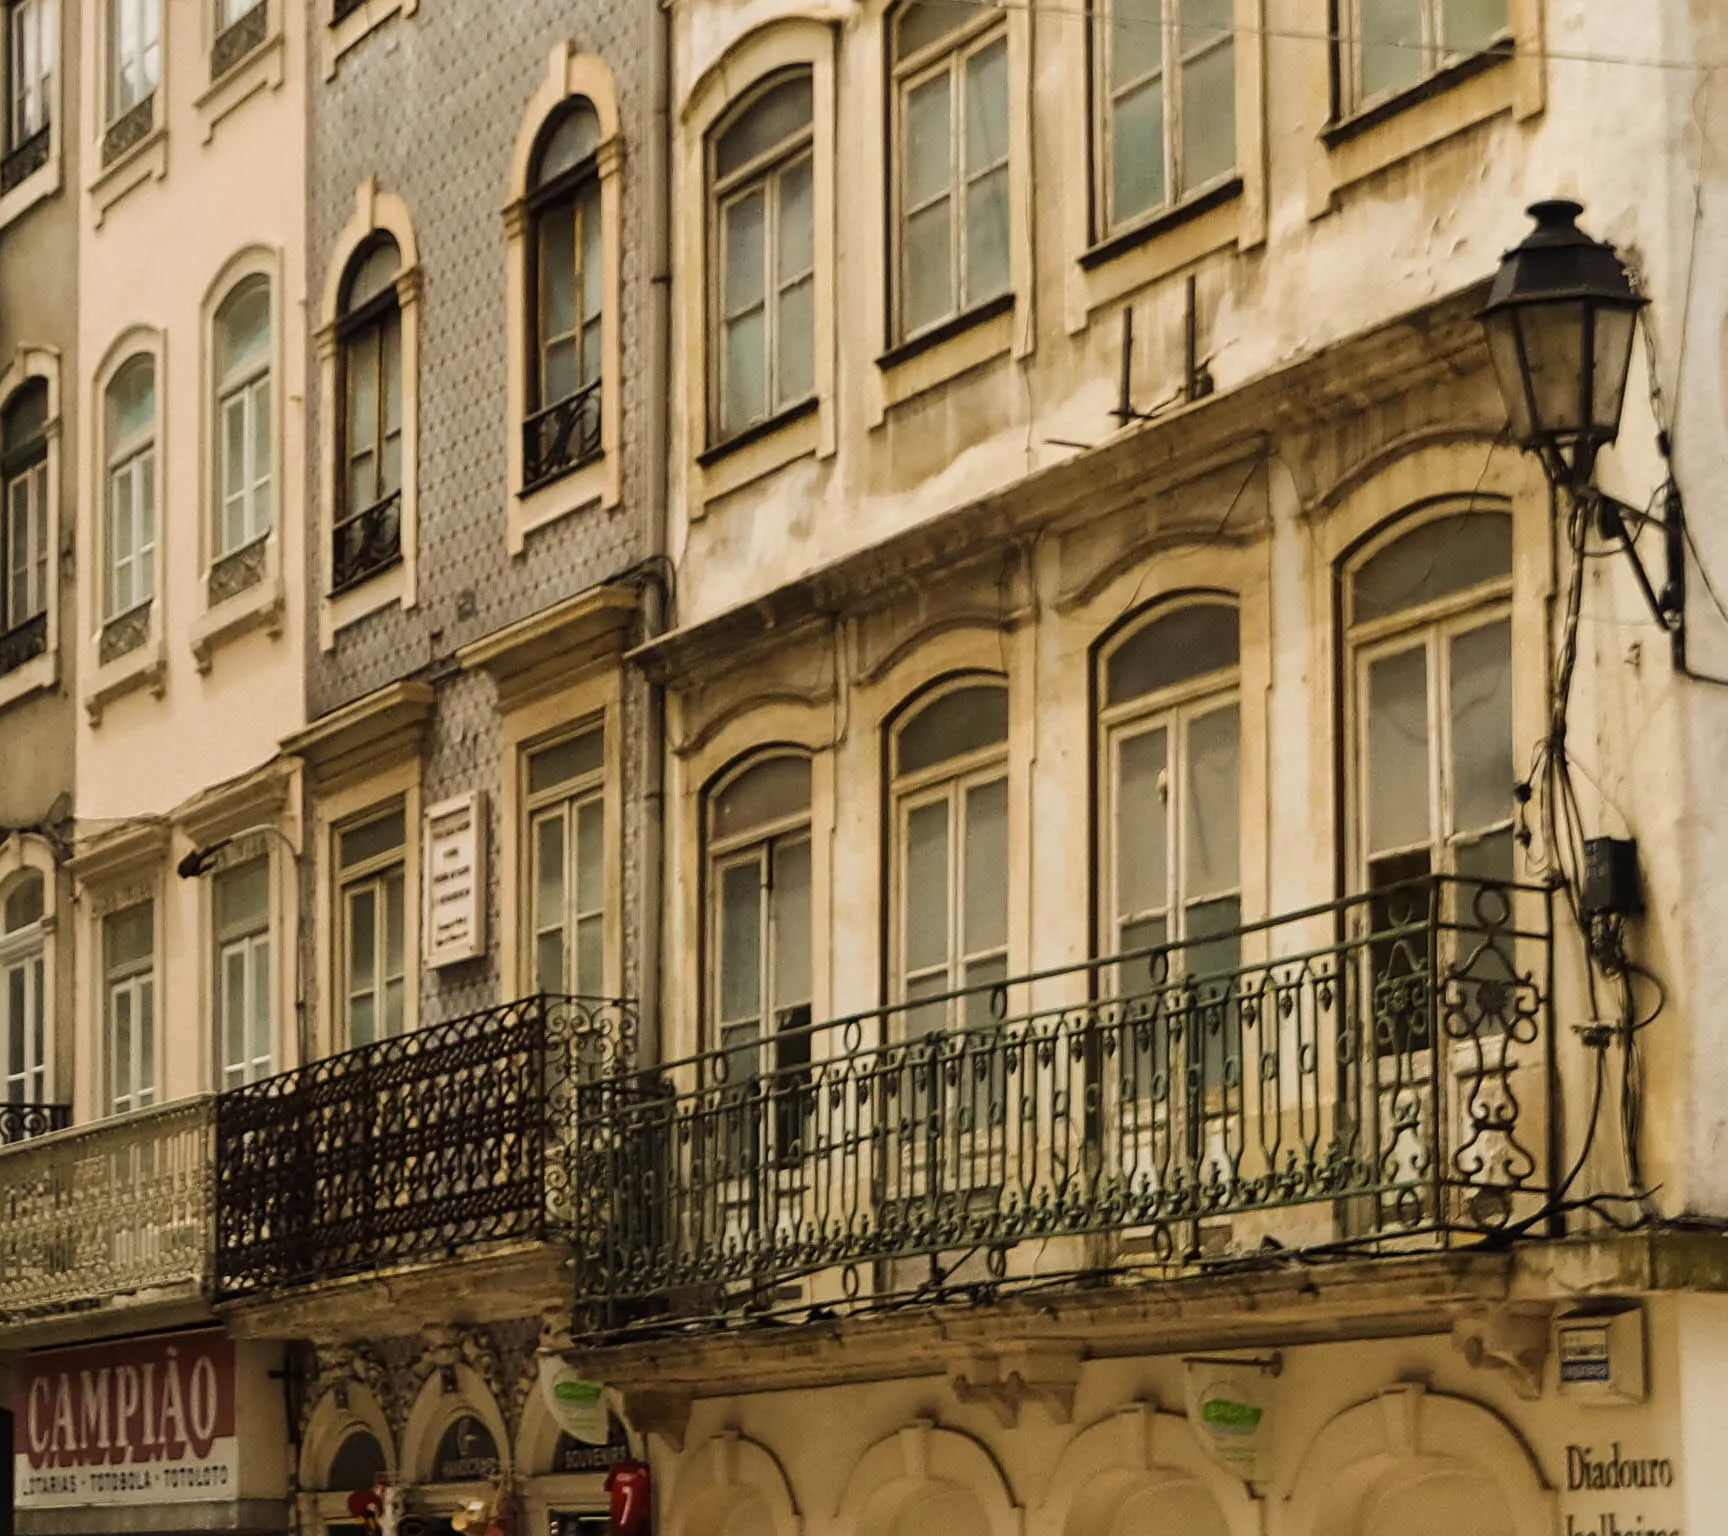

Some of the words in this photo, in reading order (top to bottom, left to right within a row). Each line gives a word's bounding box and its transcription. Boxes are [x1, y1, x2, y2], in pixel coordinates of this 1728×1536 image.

[28, 1345, 218, 1453] CAMPIÃO
[22, 1473, 77, 1495] LOTARIAS
[90, 1469, 152, 1492] TOTOBOLA
[164, 1464, 229, 1488] TOTOLOTO
